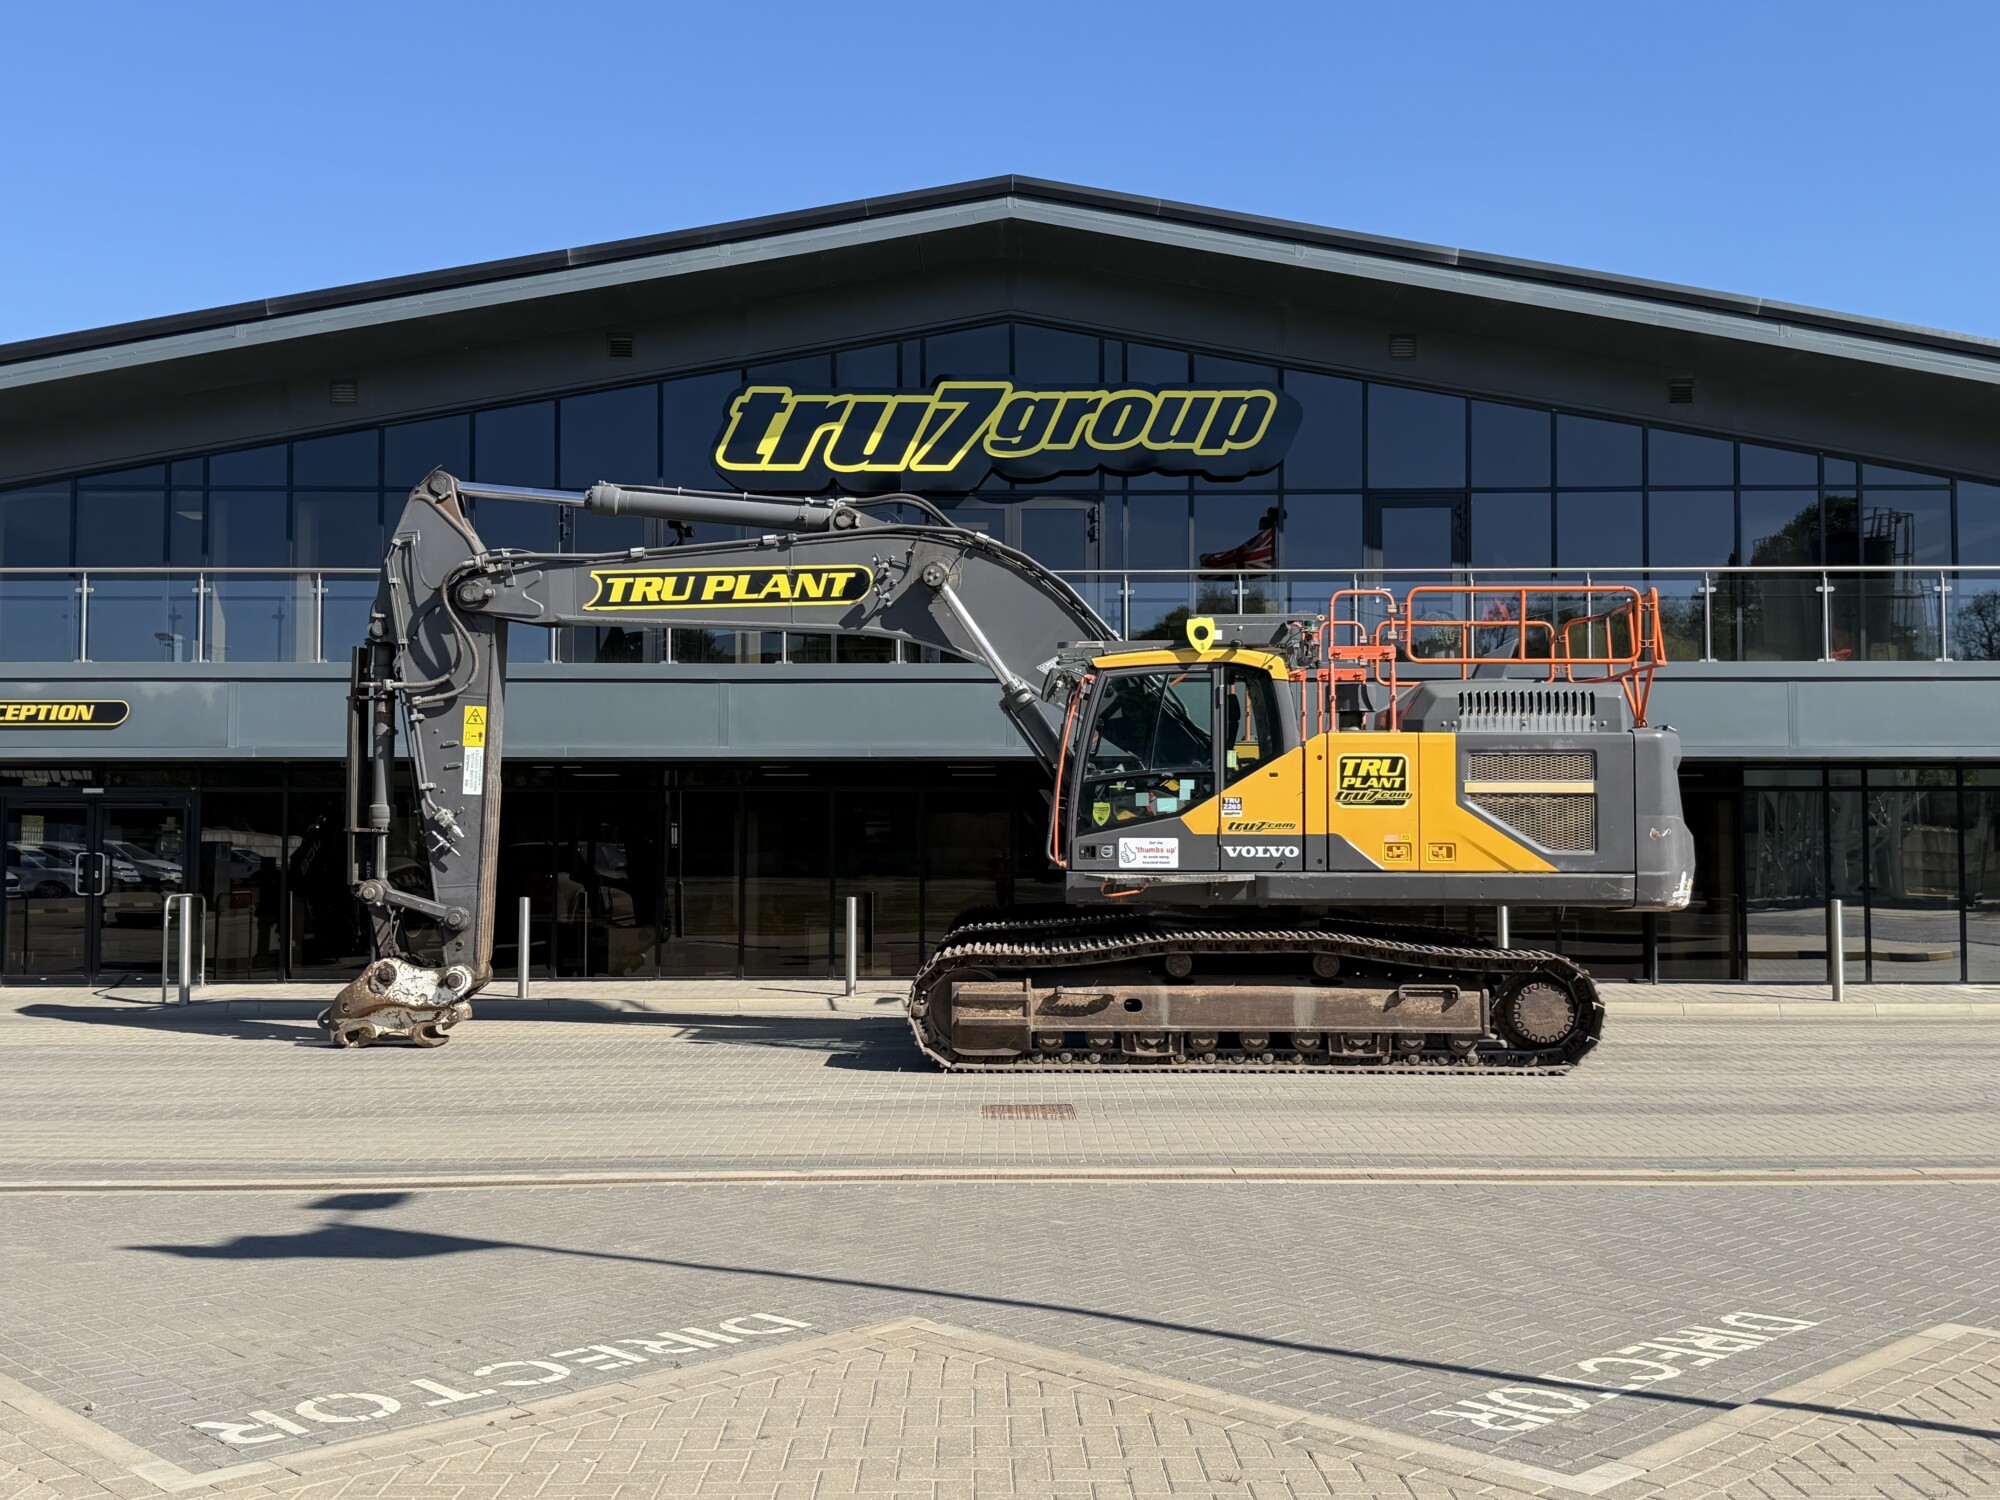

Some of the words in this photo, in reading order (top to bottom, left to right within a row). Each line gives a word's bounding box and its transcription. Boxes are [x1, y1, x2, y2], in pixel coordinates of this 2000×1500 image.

[606, 576, 695, 602] TRU
[701, 573, 855, 600] PLANT
[1341, 758, 1404, 776] TRU
[1342, 777, 1404, 788] PLANT
[1223, 846, 1299, 857] VOLVO
[193, 1313, 812, 1445] DIRECTOR
[1429, 1312, 1820, 1431] DIRECTOR
